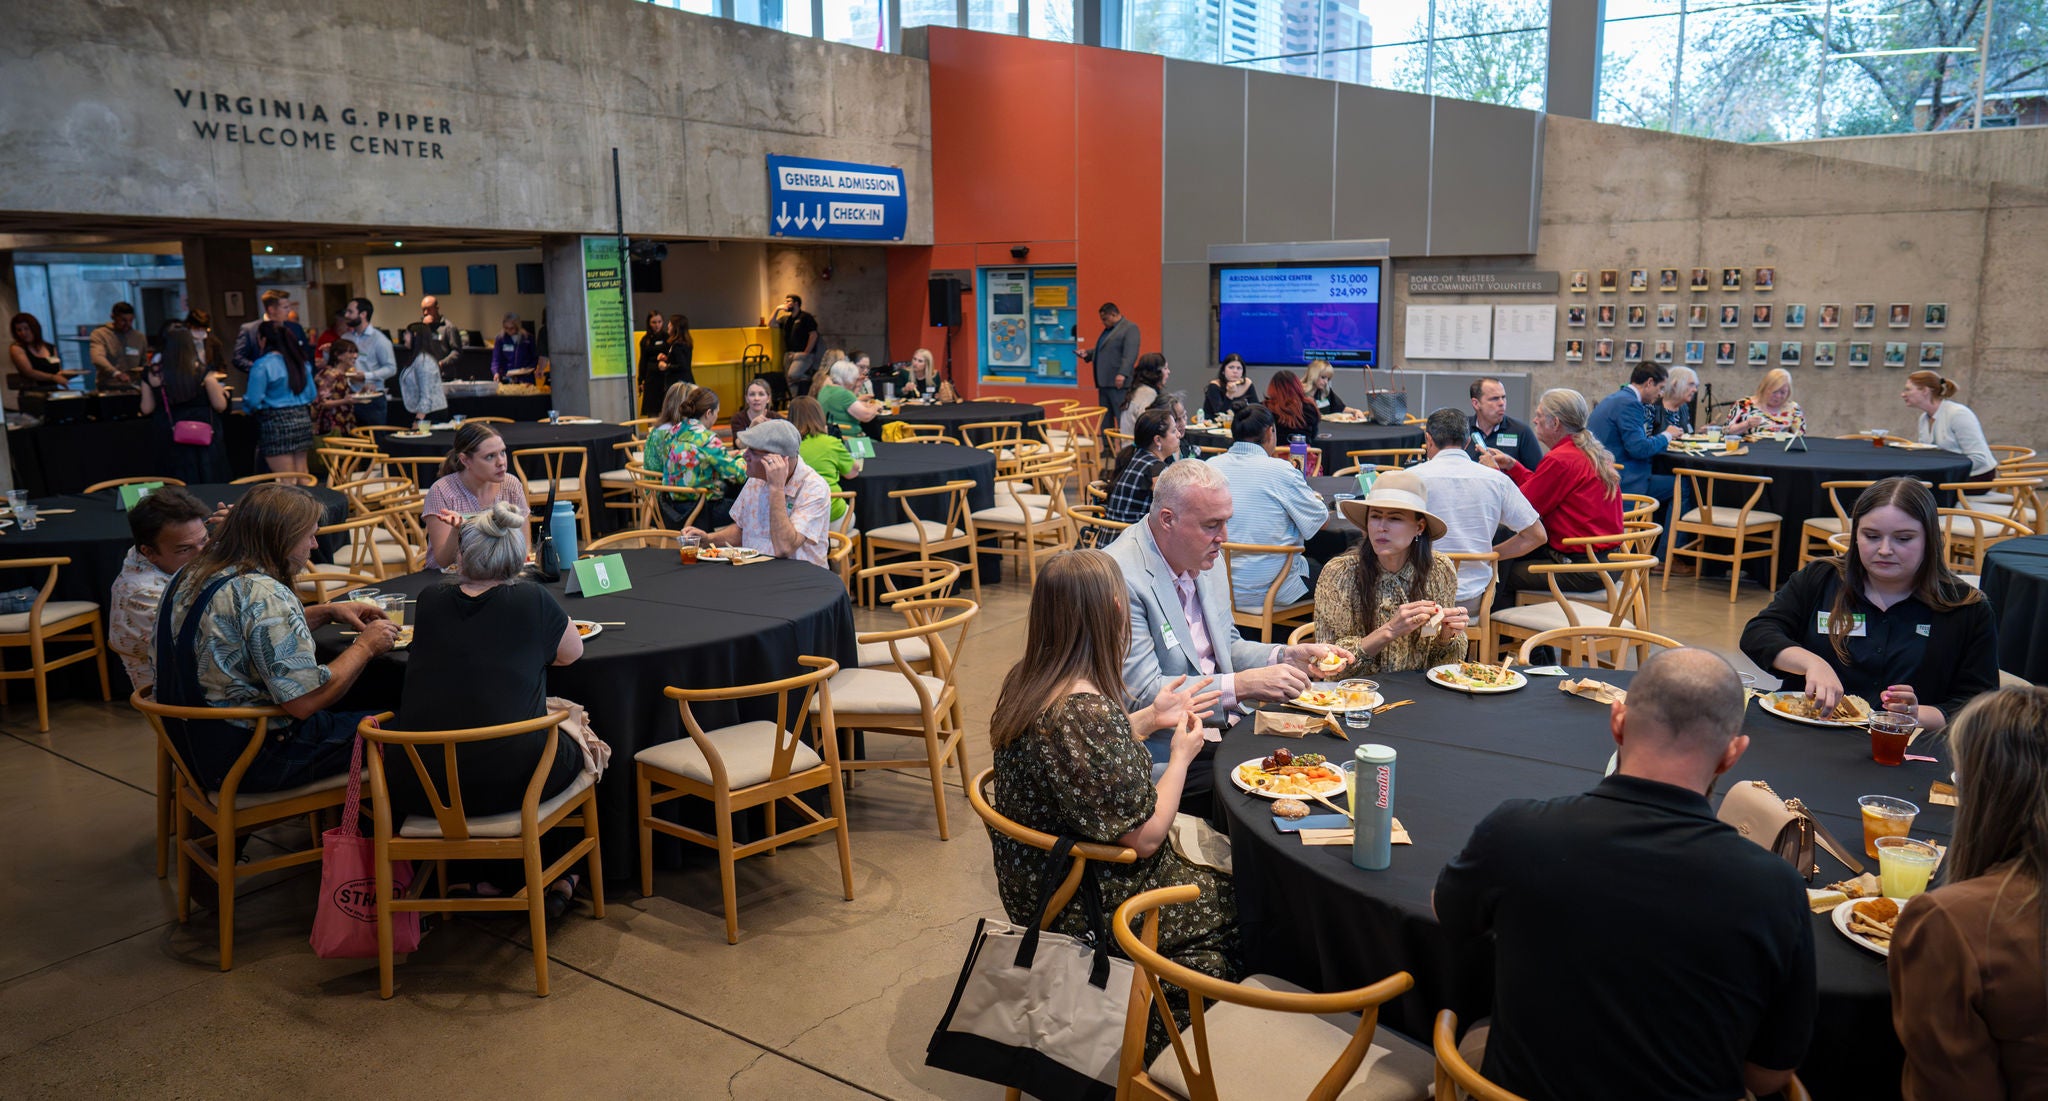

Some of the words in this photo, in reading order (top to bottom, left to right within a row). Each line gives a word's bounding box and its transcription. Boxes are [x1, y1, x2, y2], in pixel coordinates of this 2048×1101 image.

[174, 88, 328, 122] VIRGINIA
[341, 107, 369, 126] G.
[378, 111, 452, 135] PIPER
[193, 120, 336, 151] WELCOME
[350, 135, 444, 160] CENTER
[785, 172, 835, 188] GENERAL
[838, 176, 895, 191] ADMISSION
[833, 207, 880, 221] CHECK-IN
[588, 281, 601, 289] PICK
[1330, 273, 1368, 285] $15,000
[1410, 275, 1439, 283] BOARD
[1441, 275, 1453, 283] OF
[1457, 274, 1495, 283] TRUSTEES
[1329, 287, 1368, 298] $24,999
[1410, 283, 1428, 291] OUR
[1431, 282, 1485, 291] COMMUNITY
[1488, 282, 1542, 290] VOLUNTEERS
[1376, 765, 1389, 809] localist
[340, 888, 402, 907] STRAD
